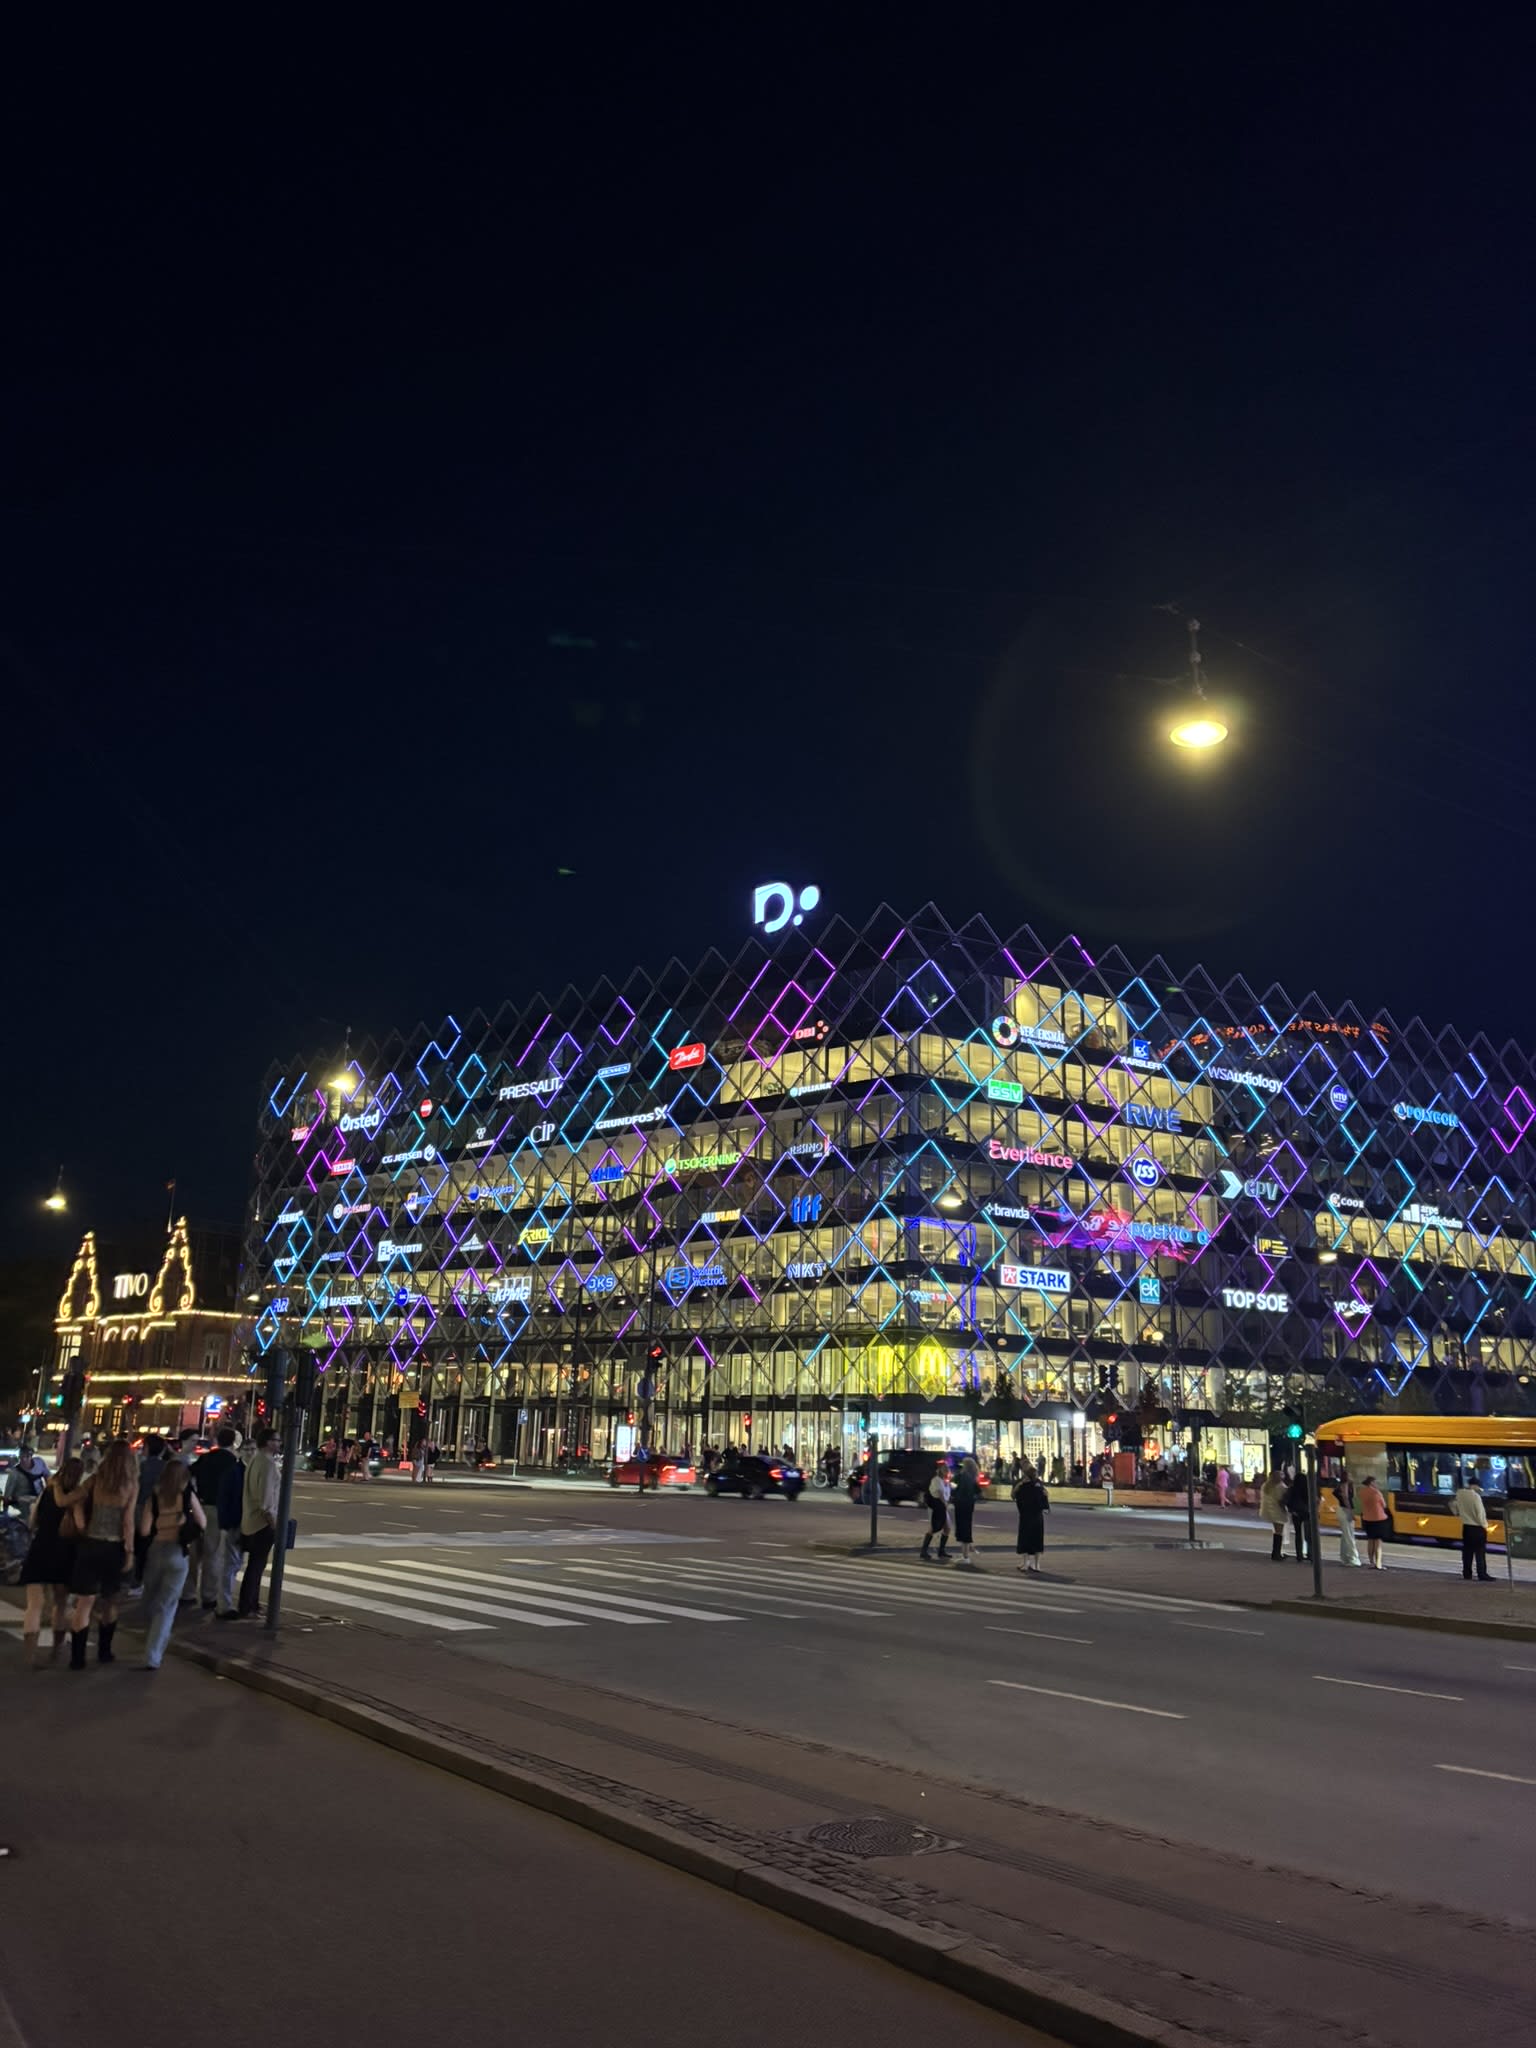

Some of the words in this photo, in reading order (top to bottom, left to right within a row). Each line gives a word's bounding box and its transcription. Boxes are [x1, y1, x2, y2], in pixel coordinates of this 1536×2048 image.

[1208, 1065, 1283, 1094] WSAudiology
[500, 1077, 563, 1101] PRESSALIT
[989, 1086, 1022, 1100] GSV
[340, 1109, 380, 1132] Ørsted
[595, 1112, 655, 1130] GRUNDFOS
[1125, 1103, 1182, 1132] RWE
[1136, 1163, 1157, 1179] ISS
[994, 1206, 1030, 1220] bravida
[1019, 1270, 1067, 1289] STARK
[1140, 1279, 1159, 1297] ek
[494, 1286, 531, 1302] KPMG
[1222, 1289, 1289, 1313] TOPSOE
